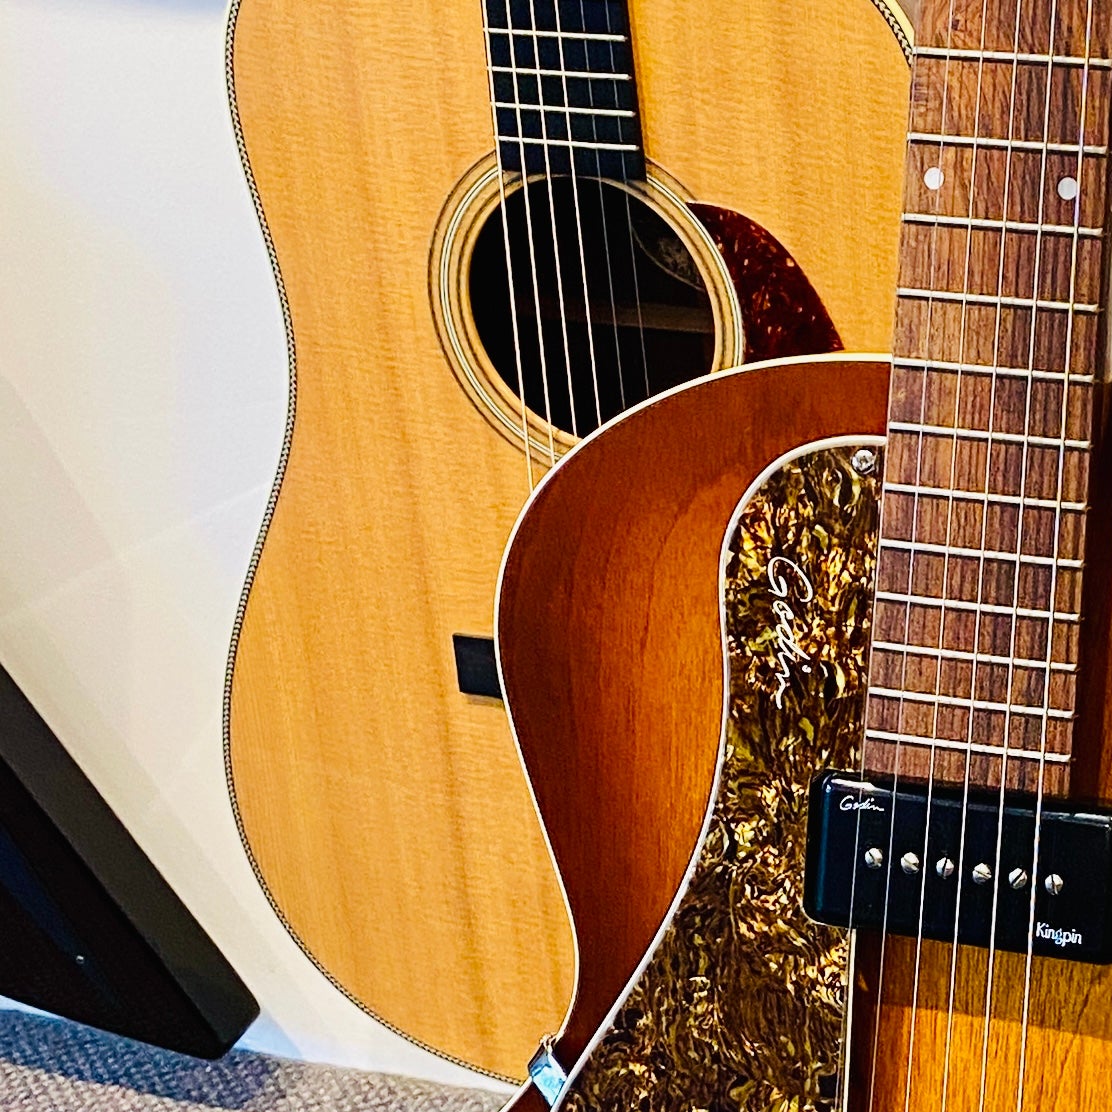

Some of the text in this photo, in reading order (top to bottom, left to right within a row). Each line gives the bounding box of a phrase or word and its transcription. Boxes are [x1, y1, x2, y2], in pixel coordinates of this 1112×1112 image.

[768, 556, 814, 709] Godin
[840, 795, 885, 812] Godin
[1036, 921, 1082, 948] Kingpin
